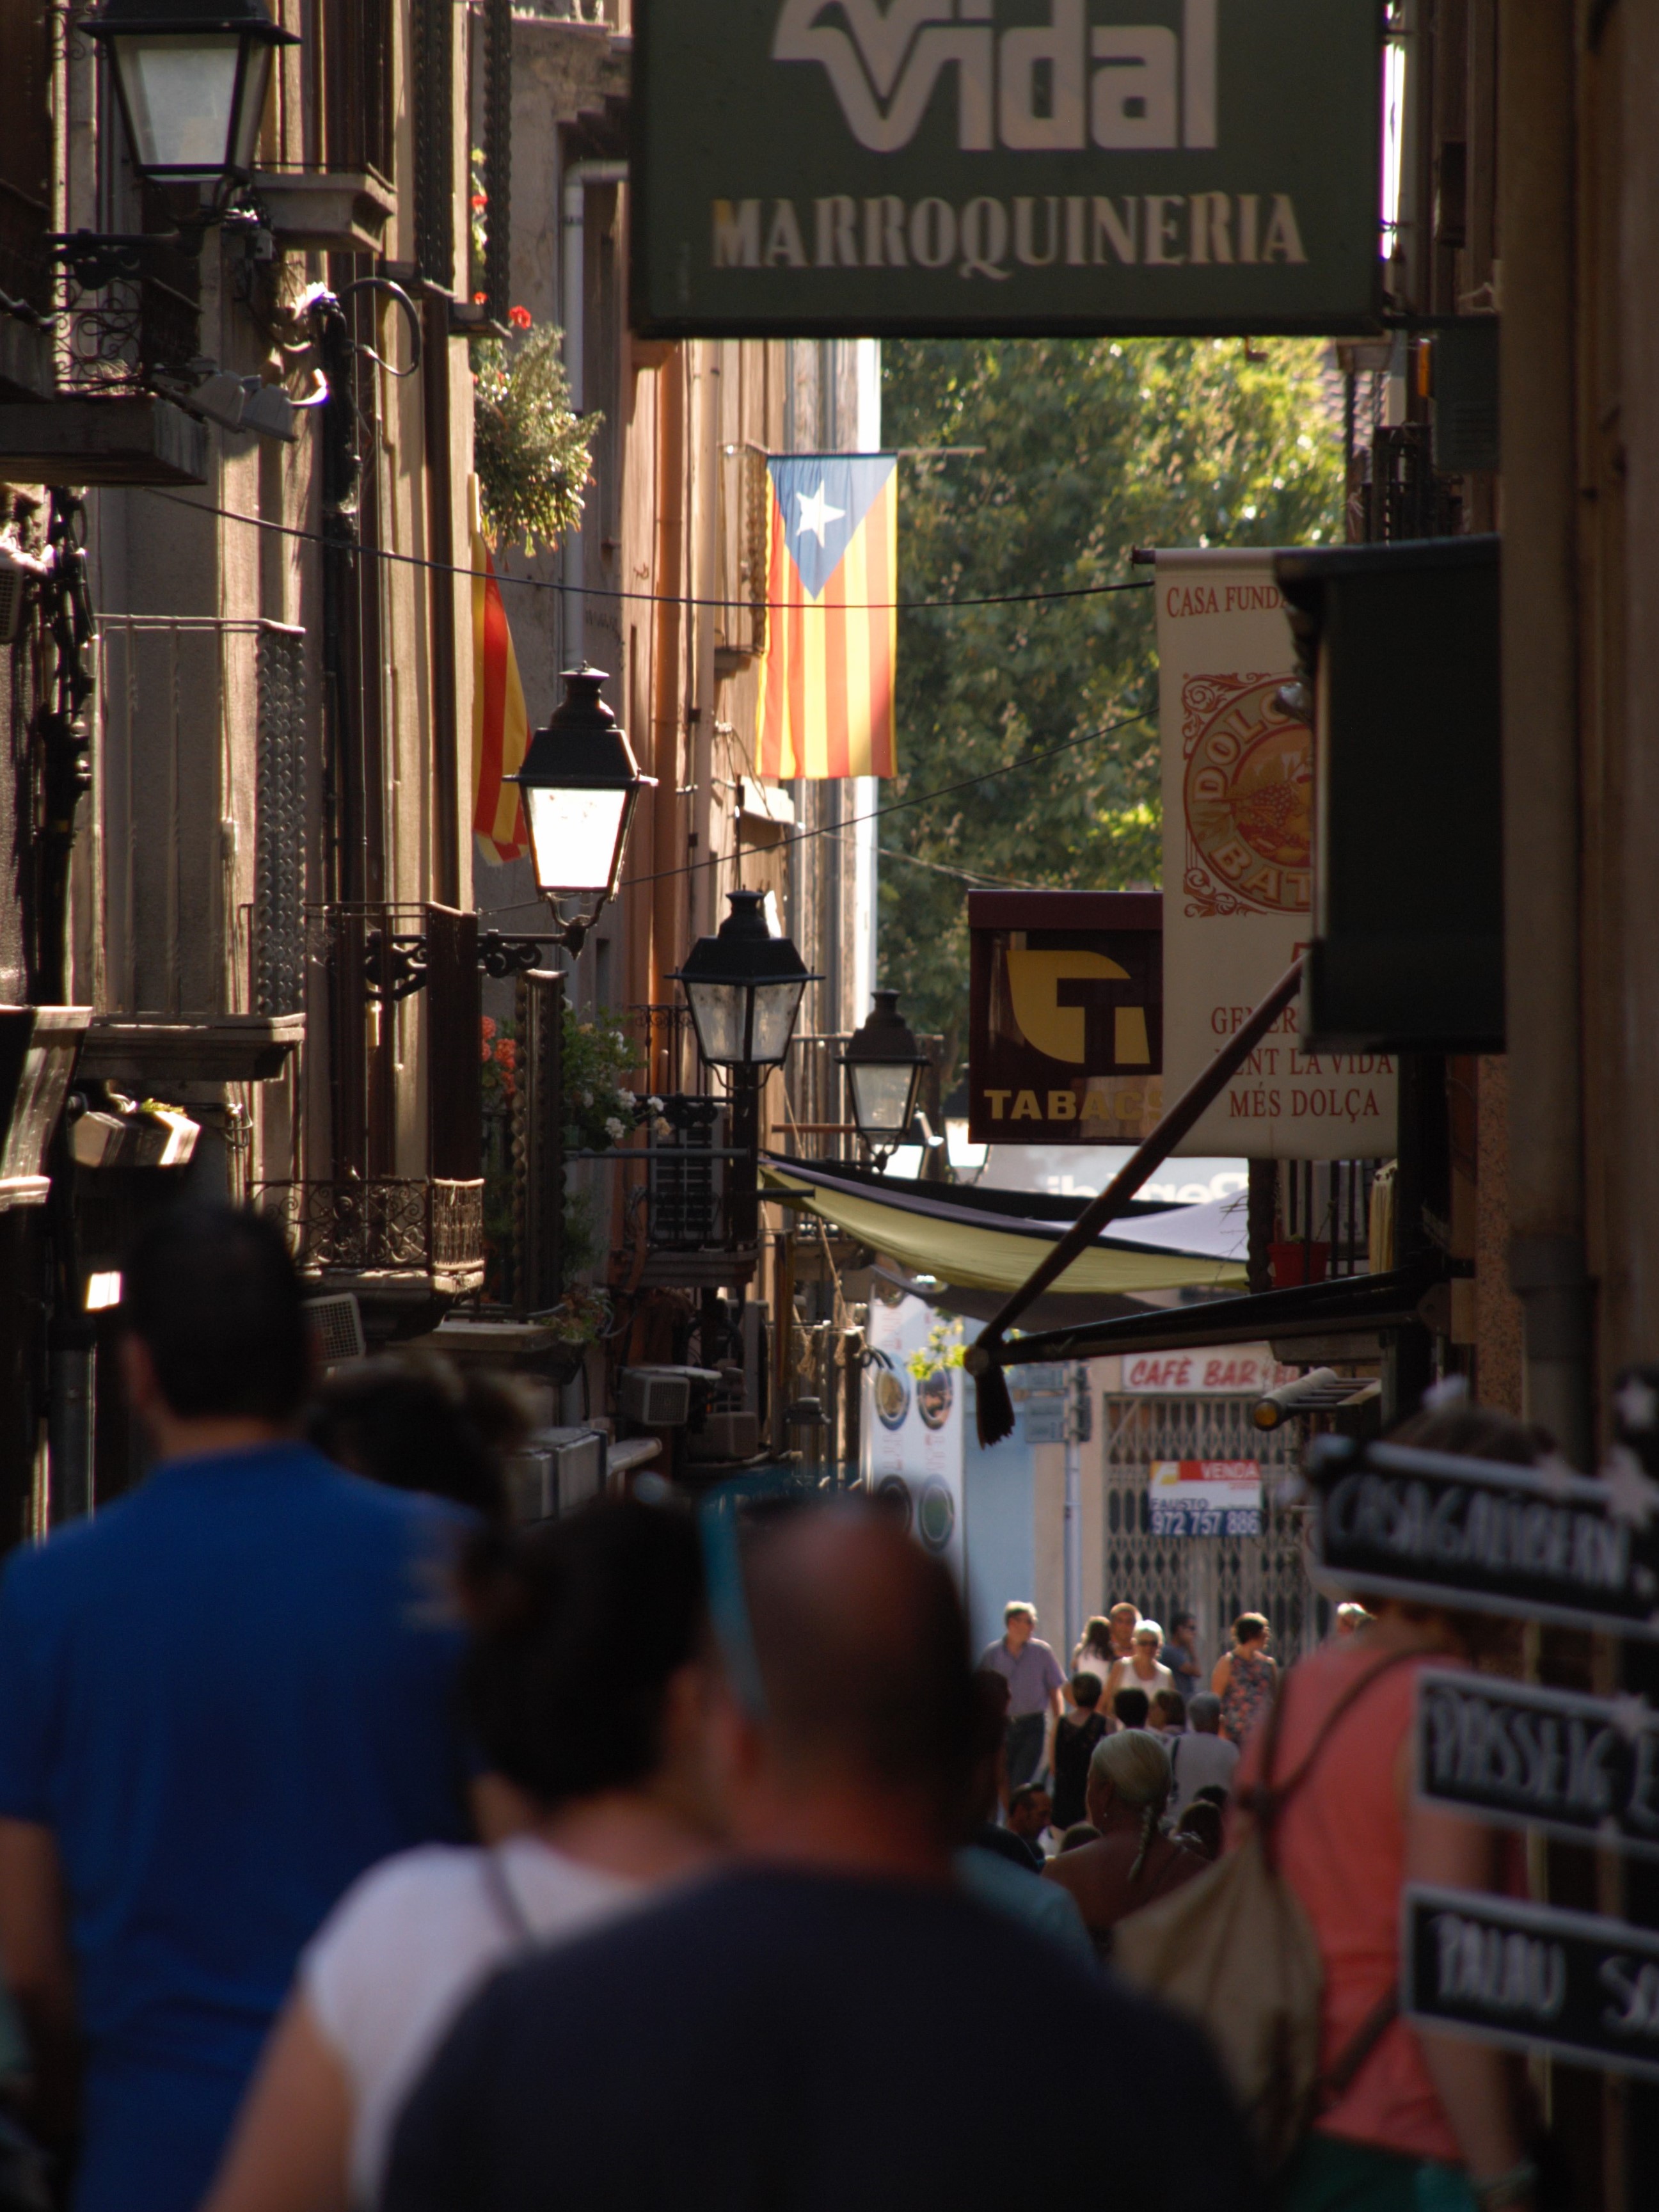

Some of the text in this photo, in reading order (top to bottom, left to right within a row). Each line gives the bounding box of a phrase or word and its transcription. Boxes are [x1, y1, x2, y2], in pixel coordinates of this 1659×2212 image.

[774, 0, 1218, 152] Vidal
[712, 192, 1308, 280] MARROQUINERIA
[1166, 585, 1289, 618] CASA FUND
[1290, 1047, 1322, 1075] LA
[1330, 1054, 1393, 1075] VIDA
[1230, 1081, 1380, 1123] MÉS DOLÇA
[1203, 1360, 1258, 1387] BAR
[1202, 1462, 1260, 1479] VENDA
[1151, 1498, 1210, 1511] FAUSTO
[1152, 1511, 1258, 1534] 972 757 886
